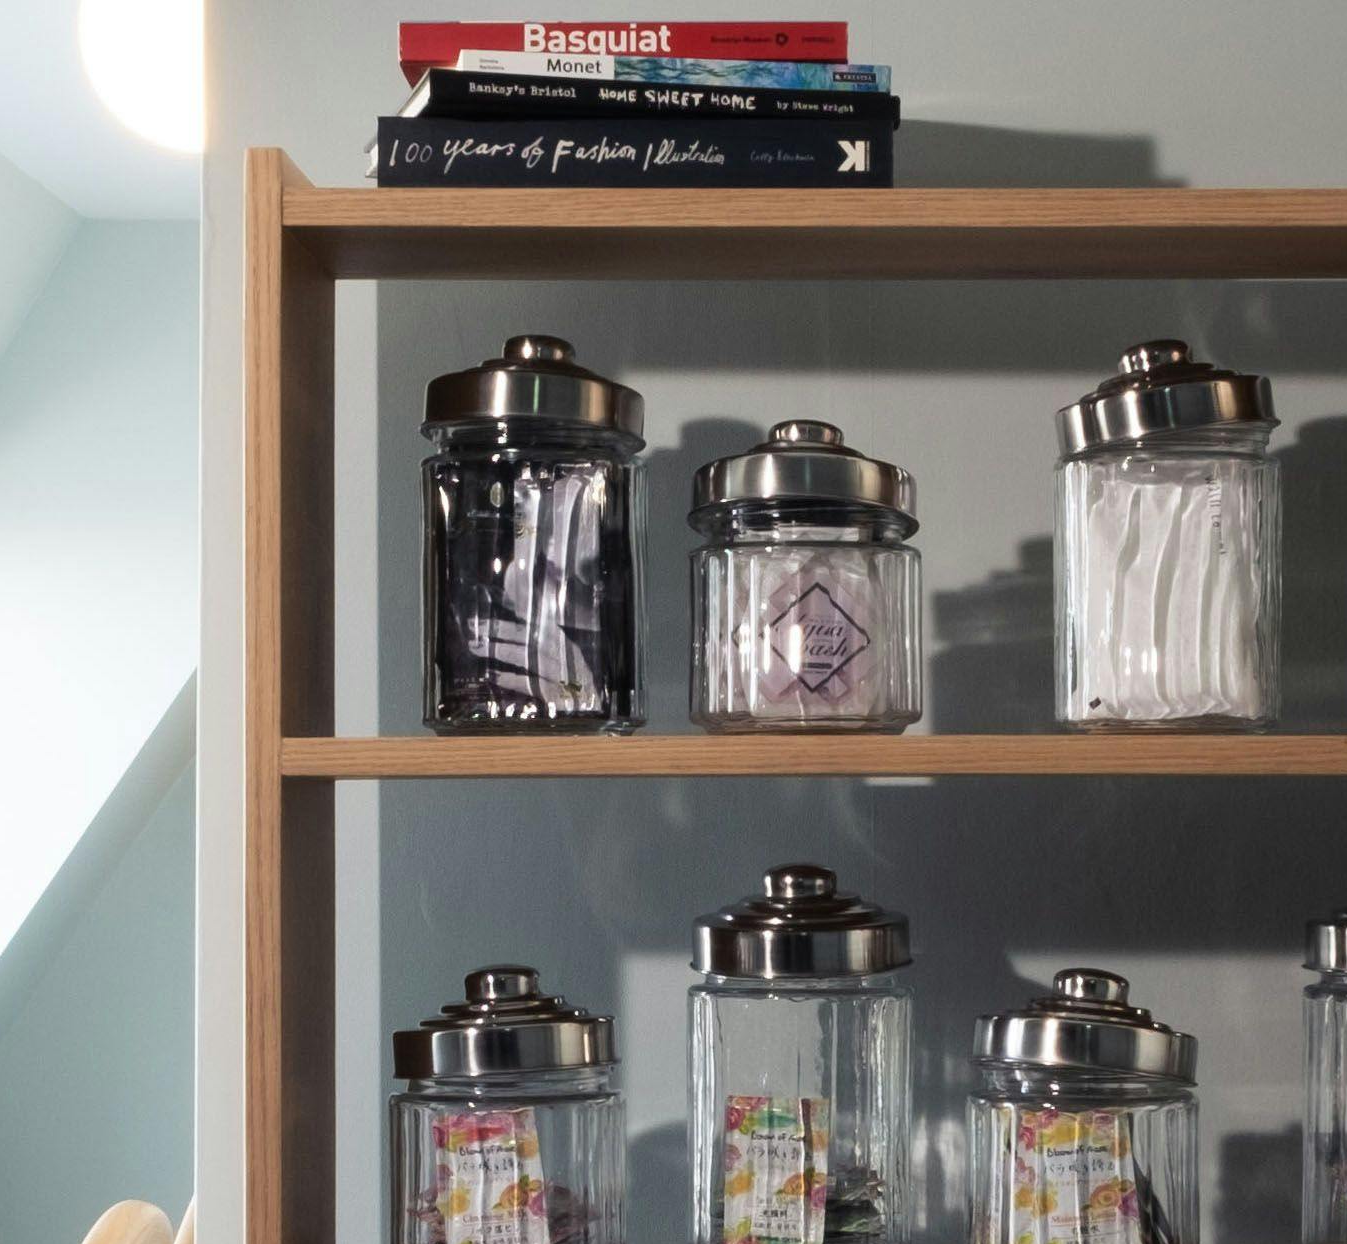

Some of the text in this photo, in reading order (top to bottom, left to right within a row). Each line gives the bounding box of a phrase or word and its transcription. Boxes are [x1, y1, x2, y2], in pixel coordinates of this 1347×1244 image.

[523, 23, 672, 55] Basquiat
[546, 58, 603, 74] Monet
[469, 82, 577, 98] Banksy's Bristol
[599, 87, 757, 110] HOME SWEET HOME
[776, 101, 789, 111] by
[389, 136, 726, 175] 100 years of Fashion Illustration
